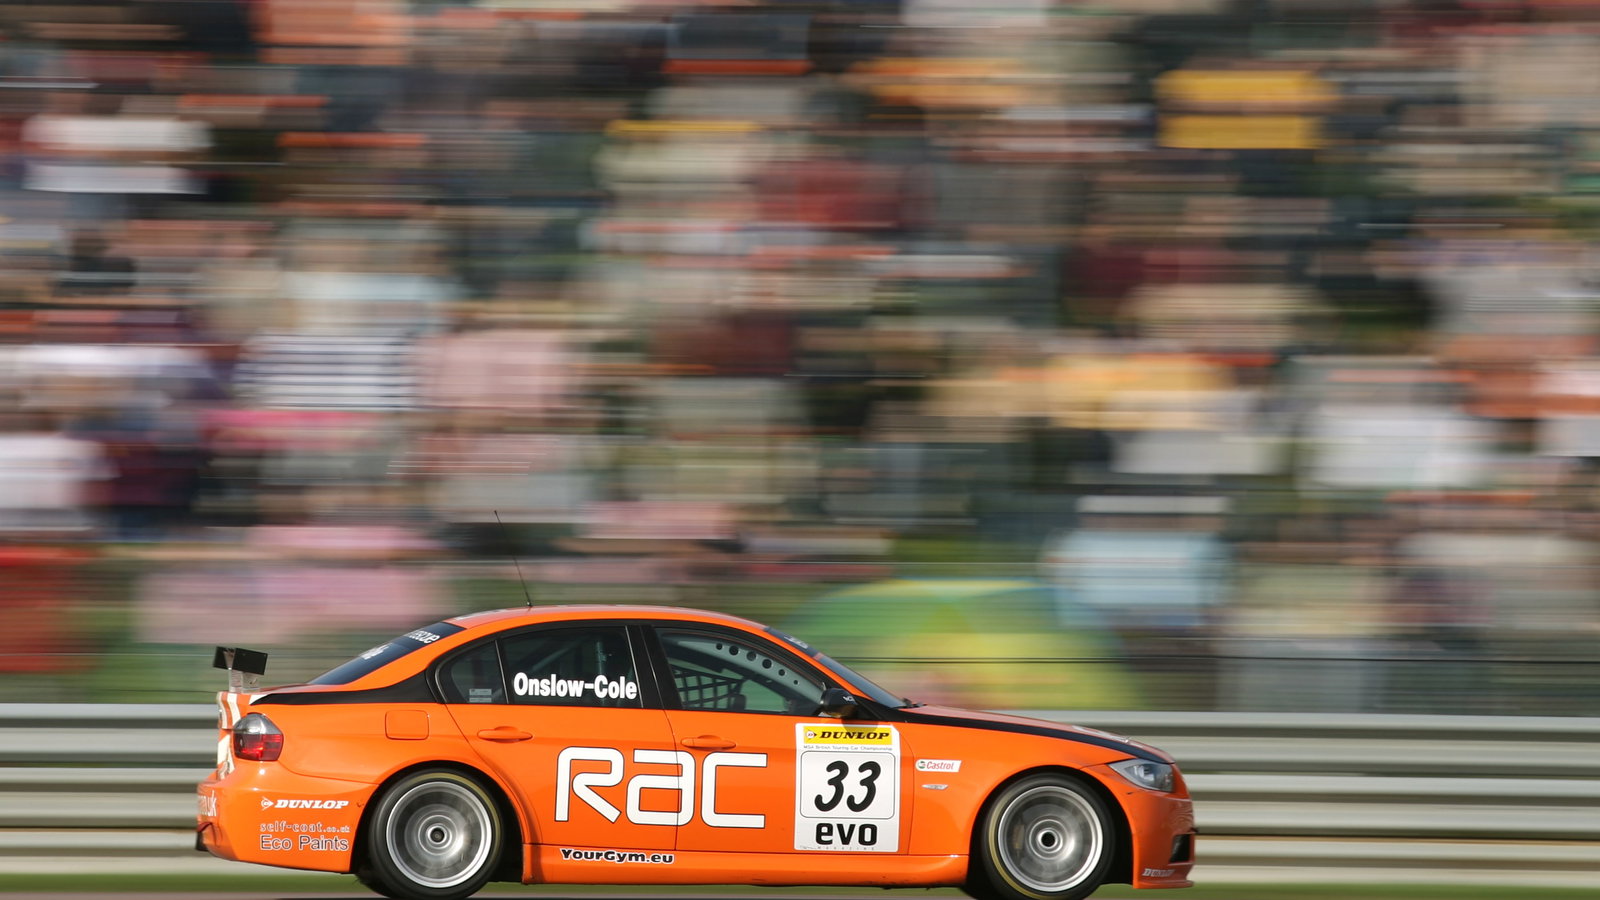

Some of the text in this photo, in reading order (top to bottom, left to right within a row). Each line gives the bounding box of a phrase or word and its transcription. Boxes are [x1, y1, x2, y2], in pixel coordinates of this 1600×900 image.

[513, 672, 638, 700] Onslow-Cole
[820, 731, 889, 740] DUNLOP
[926, 761, 954, 770] Castrol
[814, 760, 882, 813] 33
[274, 799, 350, 809] DUNLOP
[260, 834, 350, 851] Eco Paints
[815, 823, 878, 846] evo
[560, 848, 674, 865] YourGym.eu
